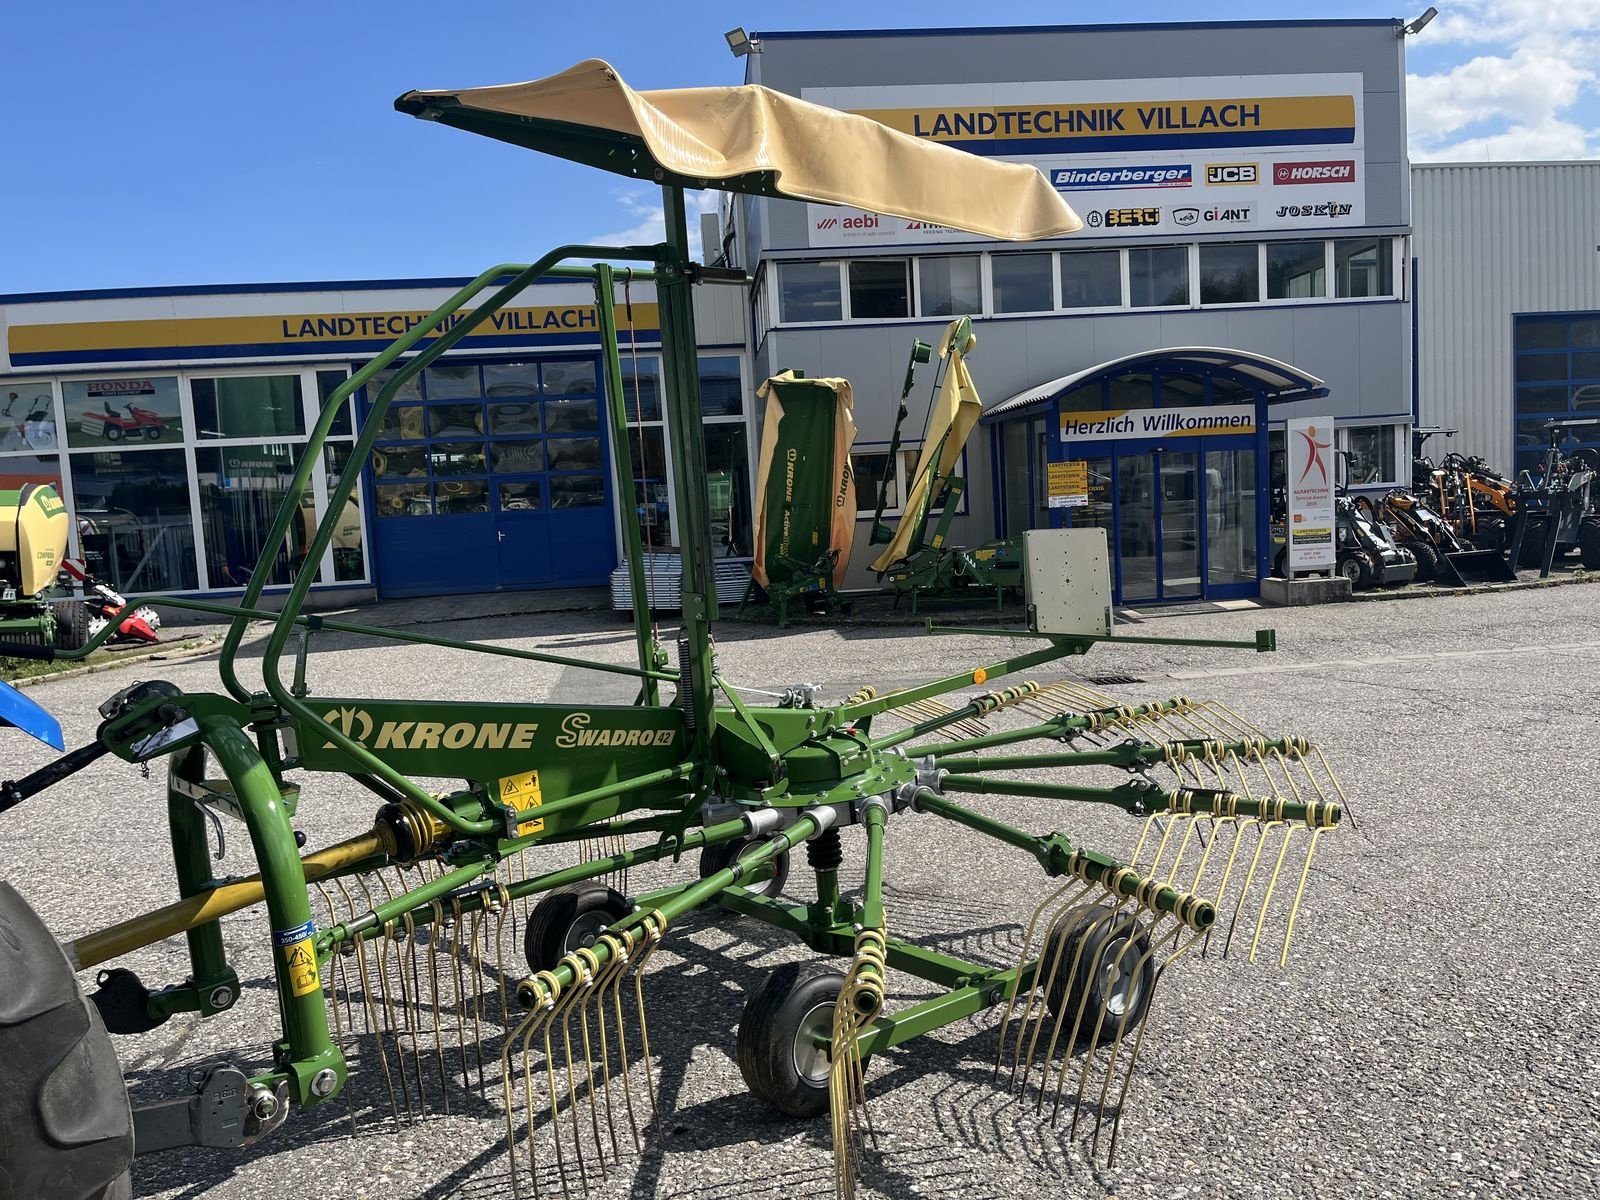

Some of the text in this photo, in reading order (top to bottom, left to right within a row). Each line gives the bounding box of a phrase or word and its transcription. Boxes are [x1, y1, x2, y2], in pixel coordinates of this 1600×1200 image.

[914, 104, 1260, 137] LANDTECHNIK VILLACH
[1055, 169, 1188, 184] Binderberger
[1210, 166, 1255, 182] JCB
[1290, 165, 1351, 179] HORSCH
[1275, 202, 1353, 218] JOSKIN
[843, 214, 879, 229] aebi
[490, 309, 597, 331] VILLACH
[87, 380, 154, 391] HONDA
[1065, 413, 1251, 436] Herzlich Willkommen
[786, 462, 794, 503] KRONE
[839, 456, 850, 496] KRON
[373, 721, 539, 749] KRONE
